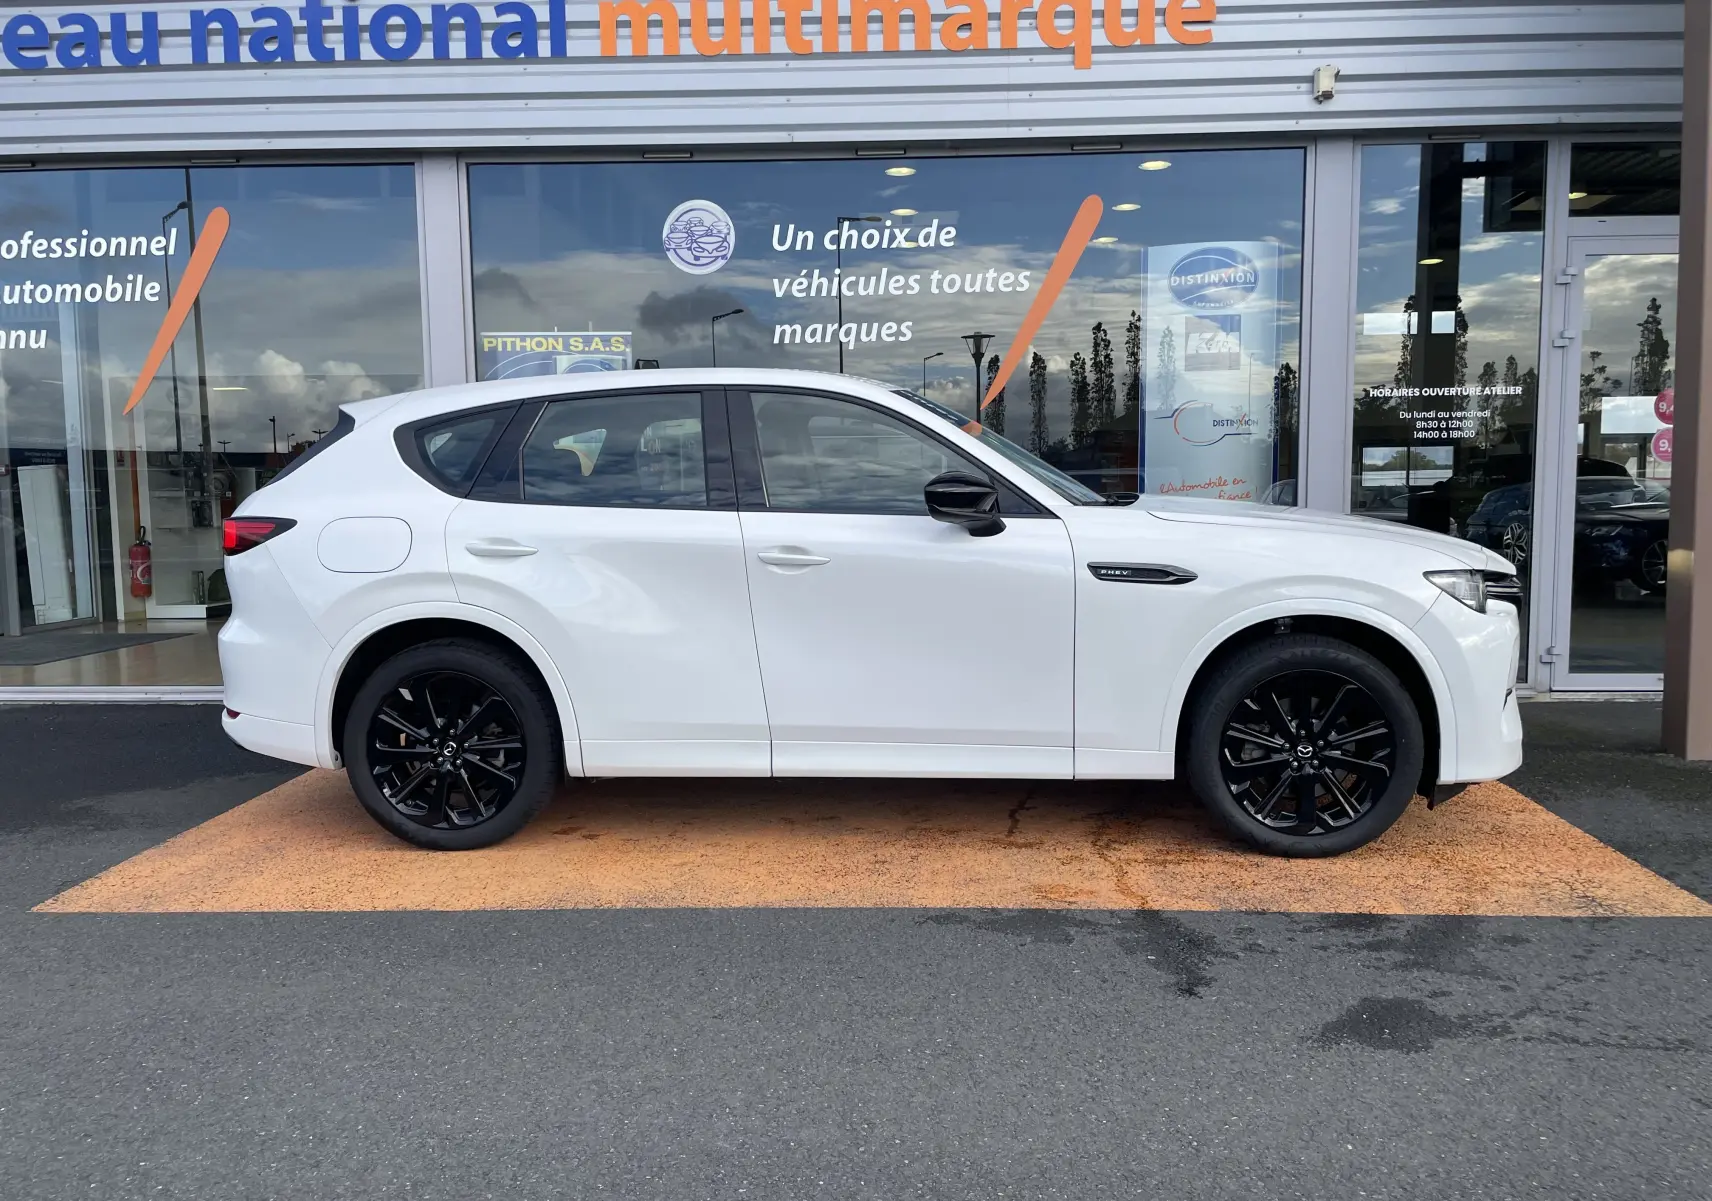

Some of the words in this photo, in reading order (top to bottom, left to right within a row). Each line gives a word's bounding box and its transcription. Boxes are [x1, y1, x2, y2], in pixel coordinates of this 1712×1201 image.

[189, 0, 567, 64] national
[598, 0, 1216, 69] multimarque
[0, 227, 178, 260] ofessionnel
[772, 222, 815, 251] Un
[823, 218, 911, 251] choix
[917, 217, 957, 249] de
[772, 265, 921, 298] véhicules
[929, 266, 1031, 295] toutes
[1170, 268, 1256, 288] DISTINXION
[0, 274, 161, 304] utomobile
[773, 317, 914, 349] marques
[482, 336, 564, 352] PITHON
[568, 335, 630, 352] S.A.S.
[1369, 387, 1420, 398] HORAIRES
[1421, 386, 1482, 397] OUVERTURE
[1483, 385, 1523, 396] ATELIER
[1212, 413, 1259, 430] DISTINXION
[1399, 411, 1412, 419] Du
[1413, 410, 1436, 419] lundi
[1437, 411, 1450, 419] au
[1451, 410, 1491, 419] vendredi
[1415, 420, 1438, 429] 8h30
[1440, 420, 1447, 429] à
[1448, 420, 1474, 428] 12h00
[1413, 430, 1440, 439] 14h00
[1441, 430, 1448, 439] à
[1449, 430, 1476, 439] 18h00
